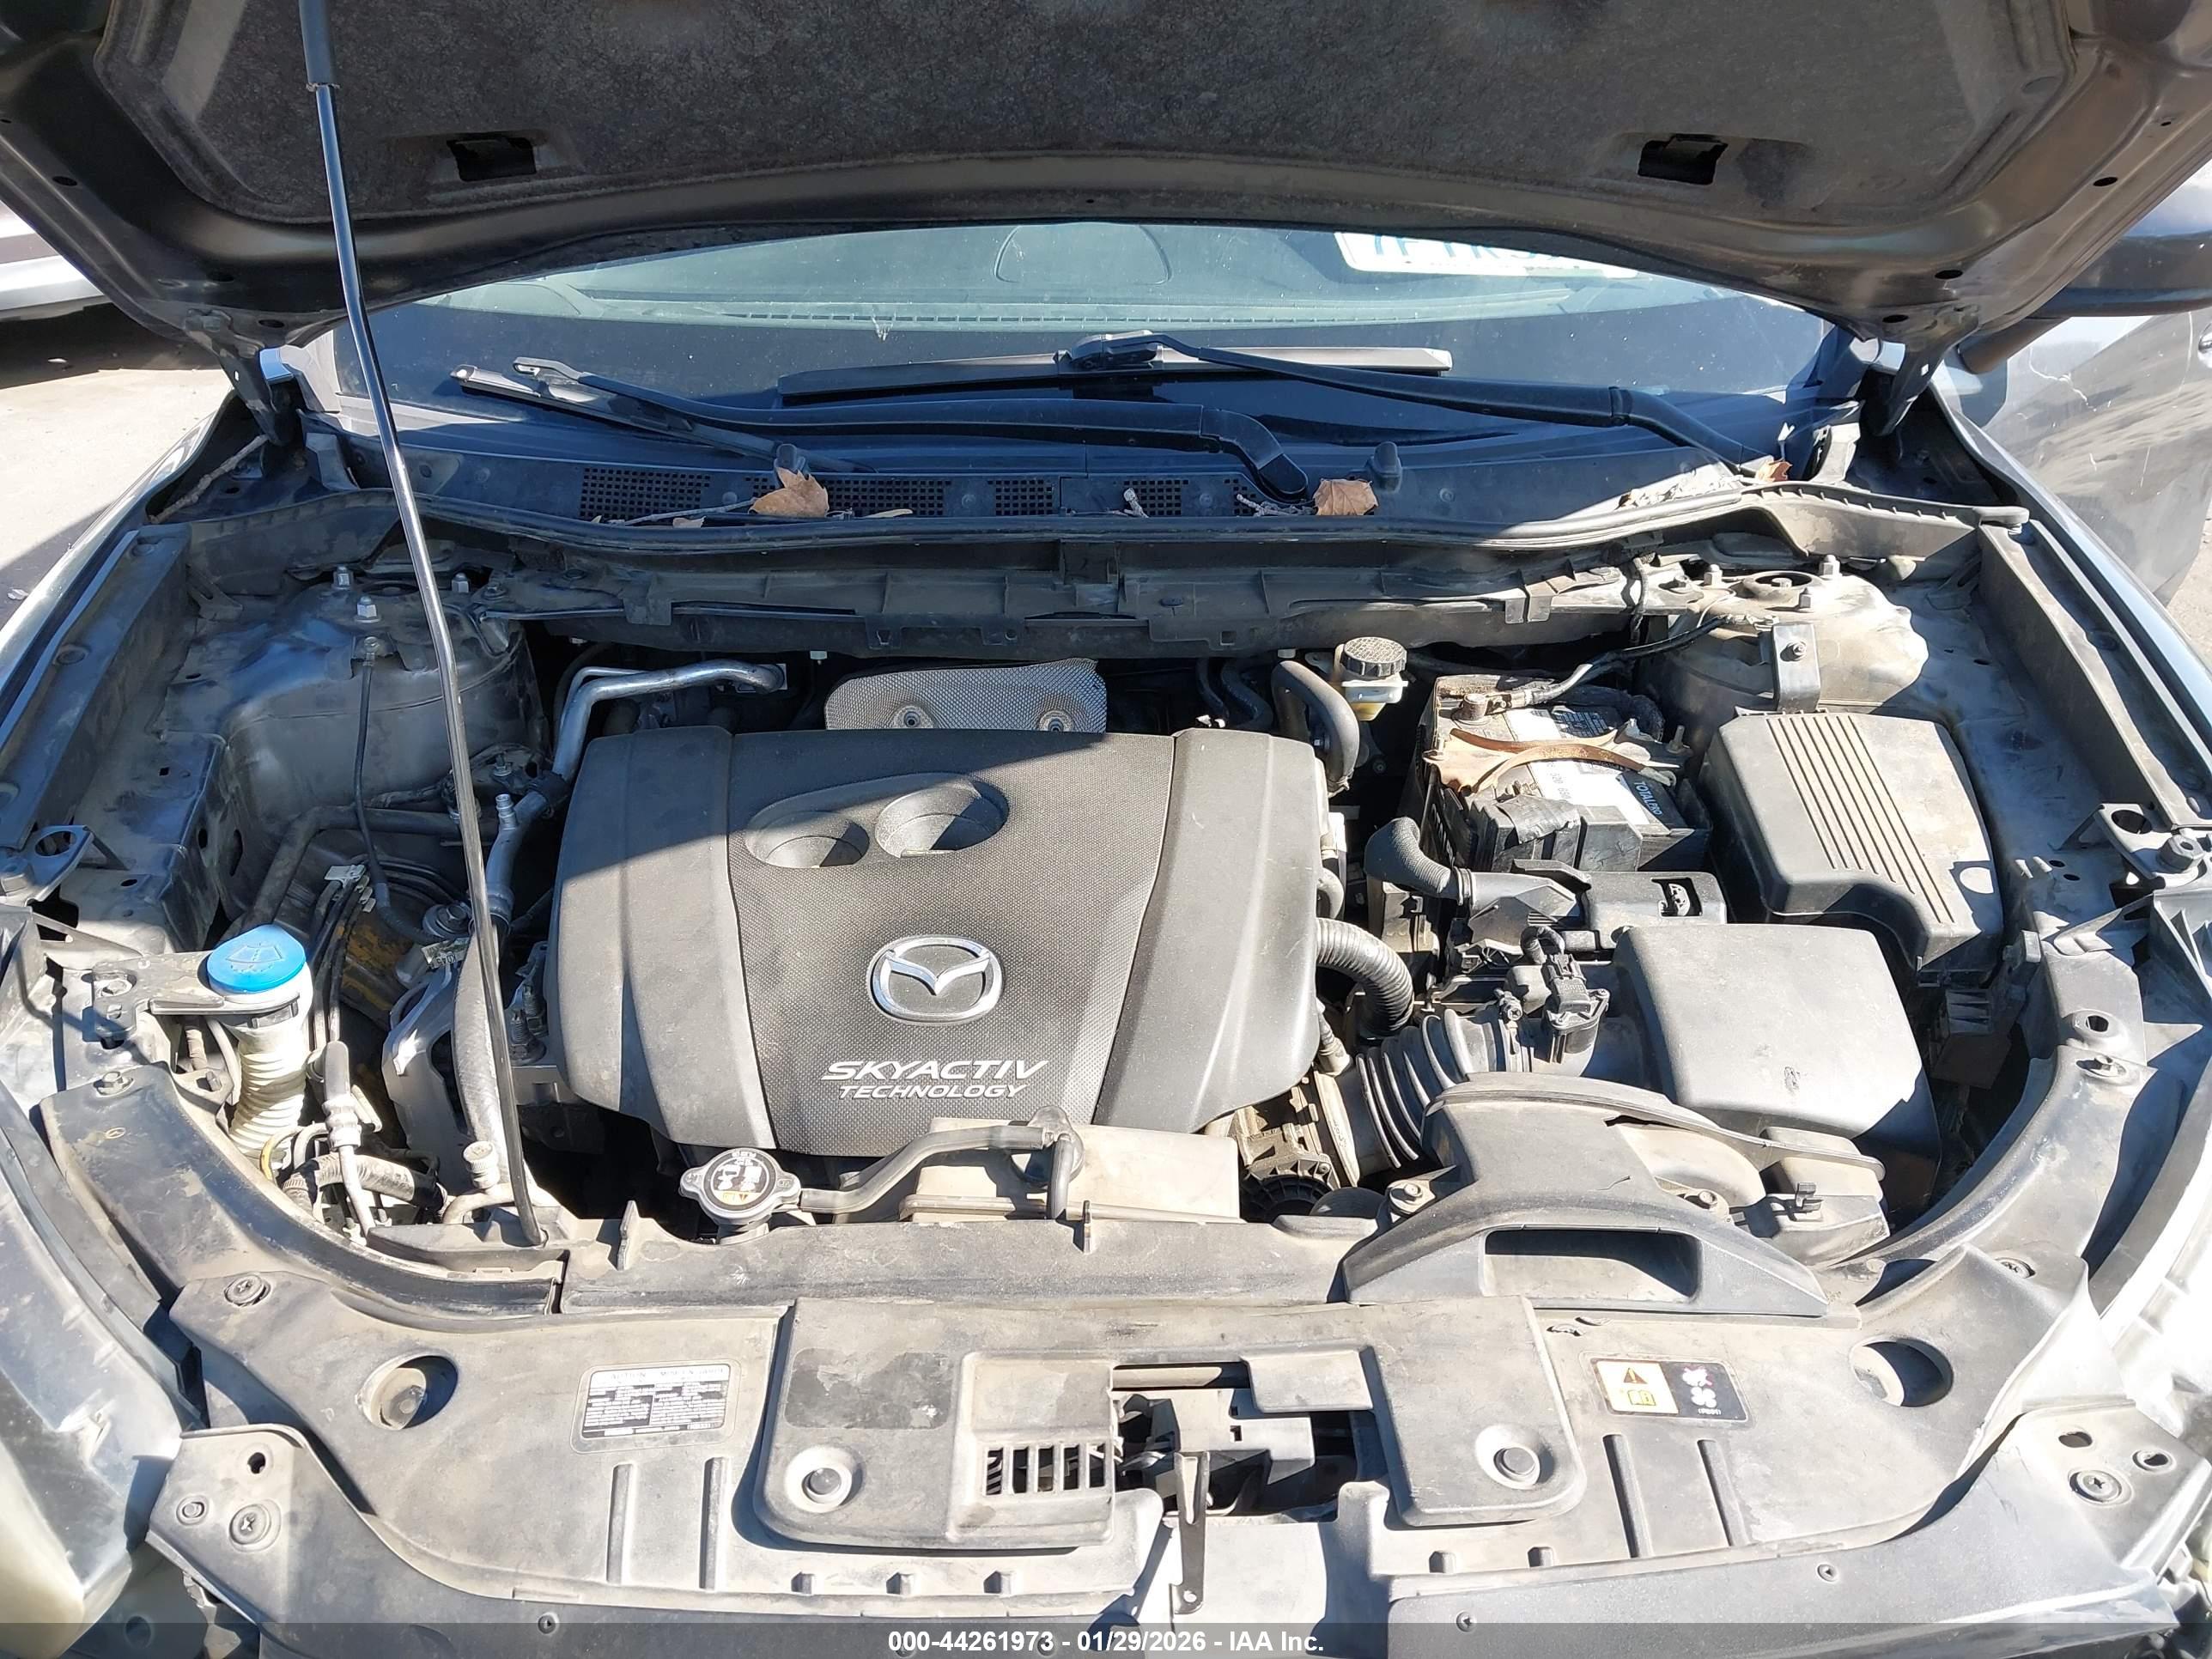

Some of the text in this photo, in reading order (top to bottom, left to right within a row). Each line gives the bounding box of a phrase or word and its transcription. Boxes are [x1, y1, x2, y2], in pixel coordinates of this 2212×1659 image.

[1633, 781, 1663, 816] TOTALPRO
[820, 1060, 1049, 1080] SKYACTIV
[839, 1085, 1028, 1100] TECHNOLOGY
